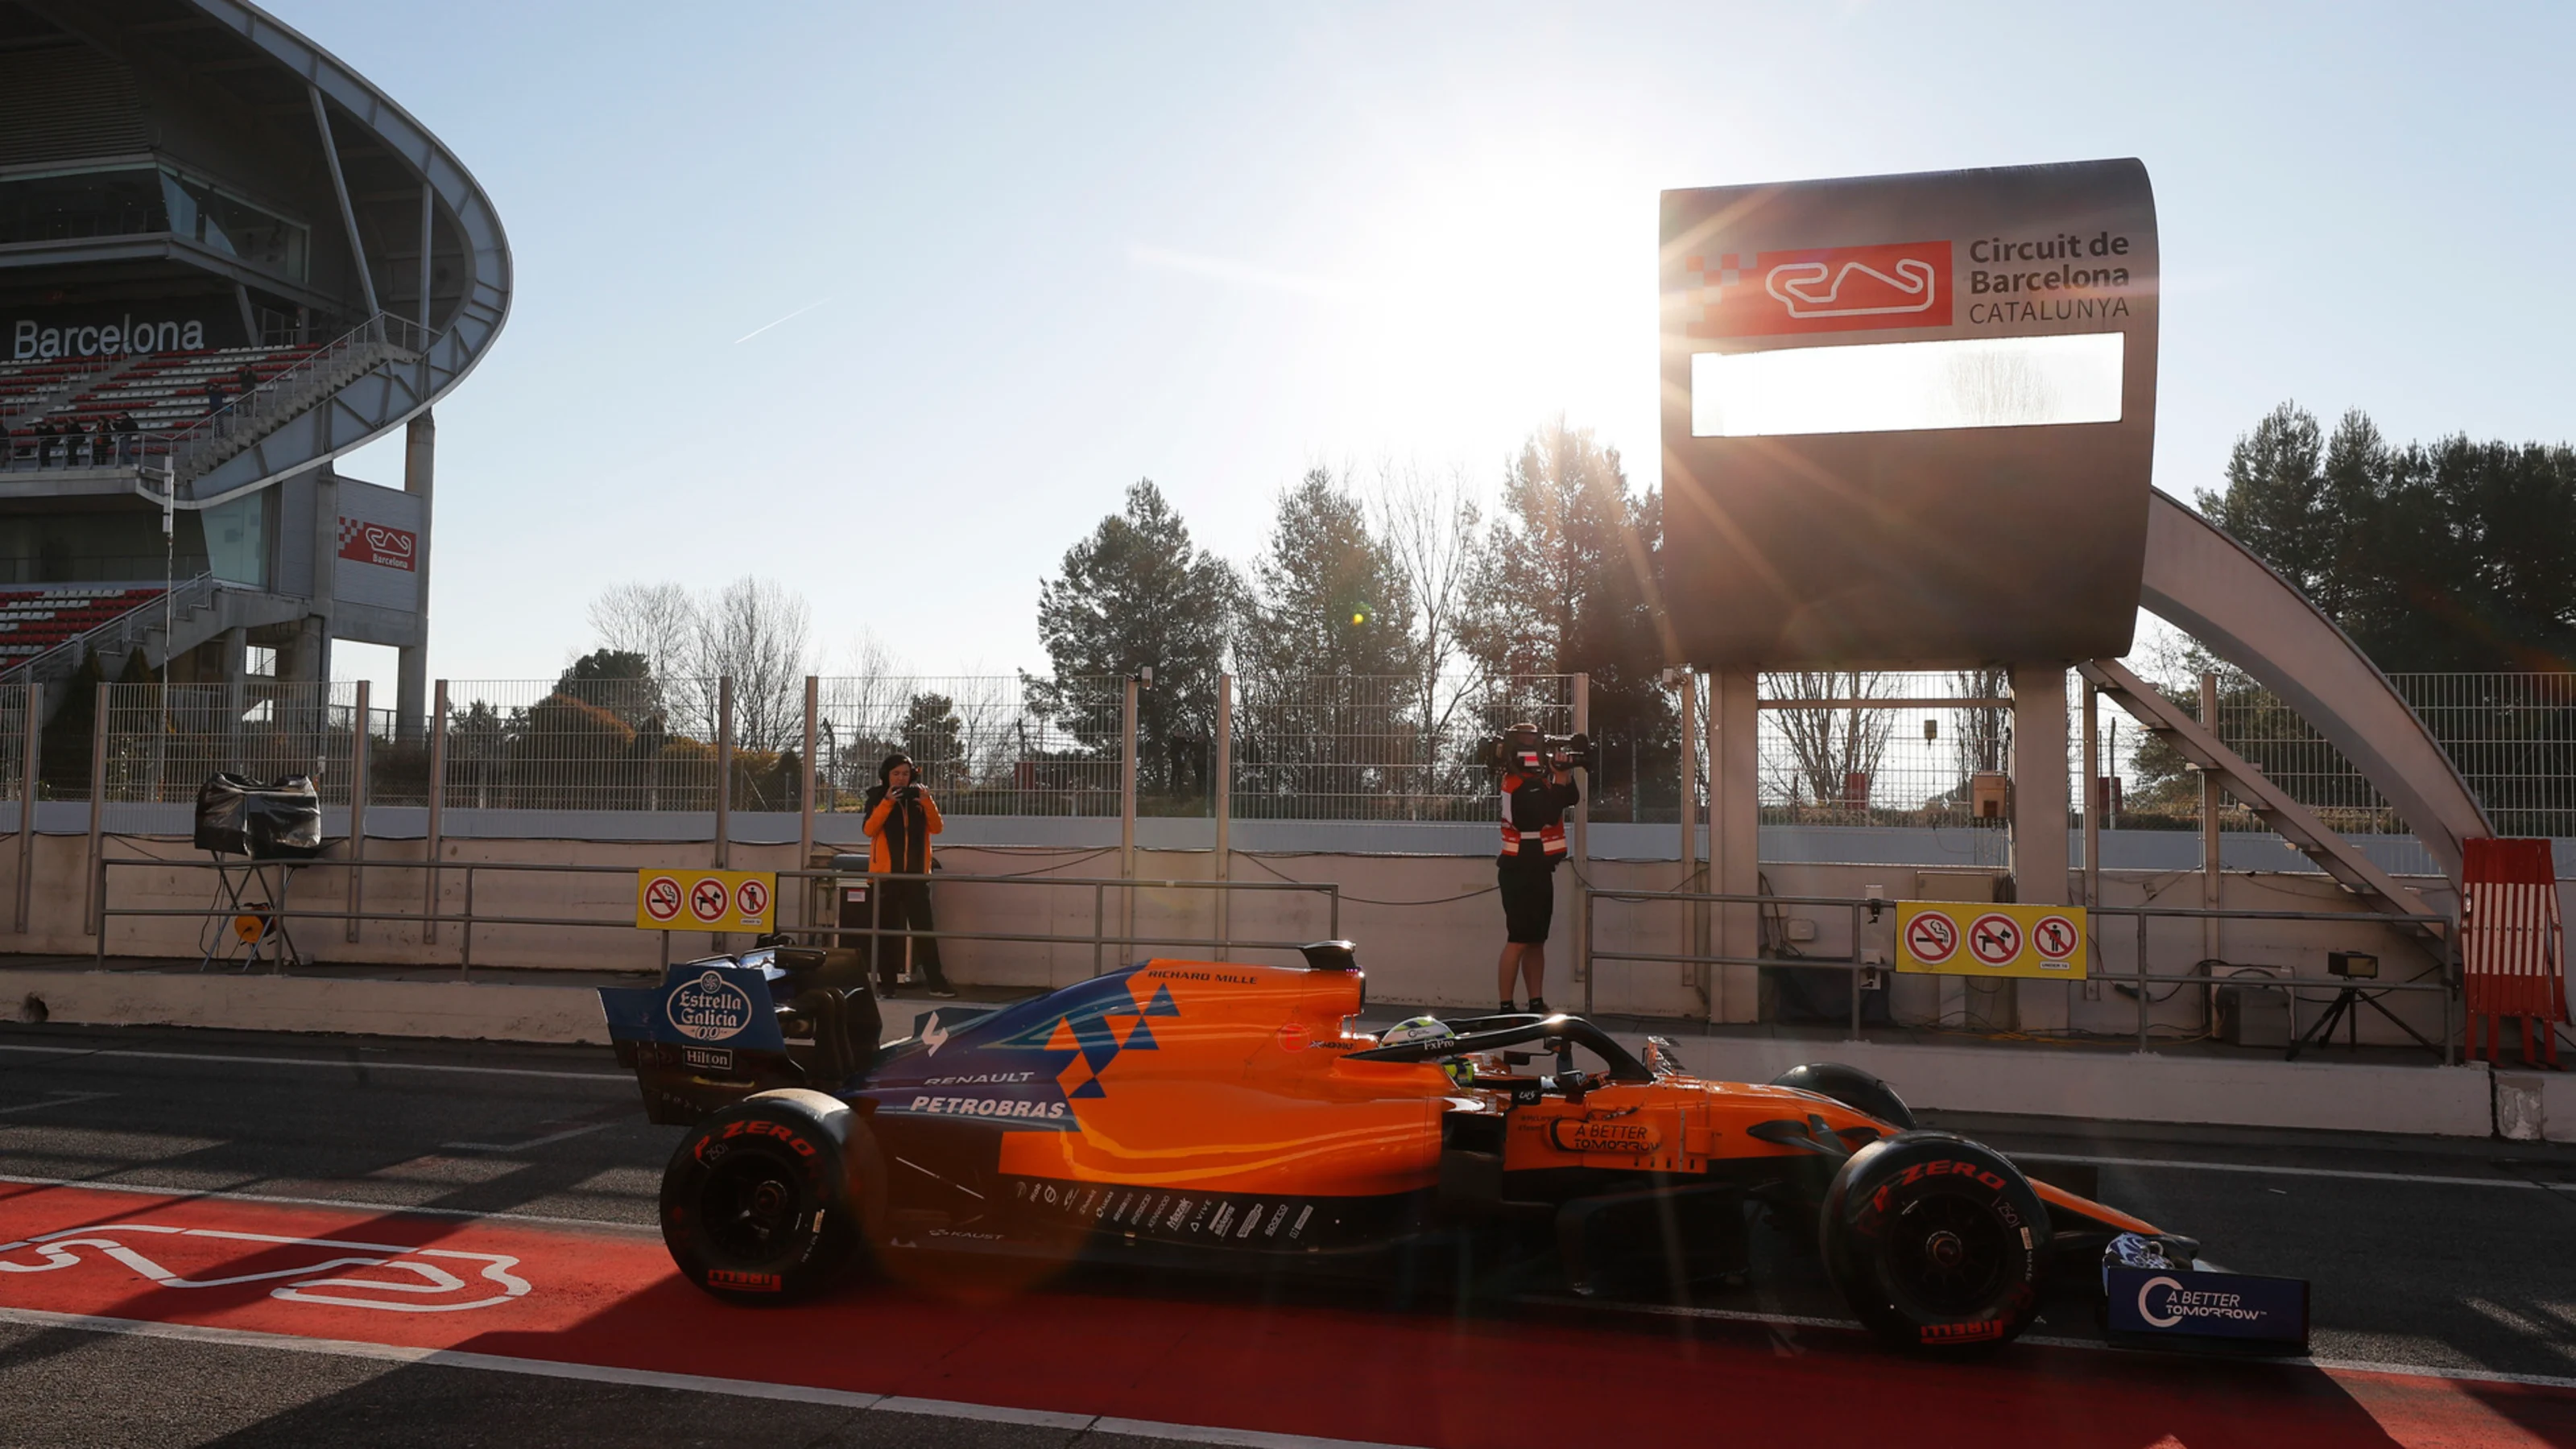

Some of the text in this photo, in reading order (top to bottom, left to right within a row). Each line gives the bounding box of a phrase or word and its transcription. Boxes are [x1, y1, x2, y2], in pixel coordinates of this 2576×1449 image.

[1970, 231, 2129, 263] Circuit de
[1971, 264, 2129, 294] Barcelona
[1970, 296, 2130, 324] CATALUNYA
[14, 313, 205, 359] Barcelona
[373, 553, 408, 568] Barcelona
[1147, 970, 1258, 985] RICHARD MILLE
[679, 991, 742, 1010] Estrella
[681, 1008, 738, 1027] Galicia
[1424, 1038, 1454, 1051] FxPro
[687, 1051, 728, 1065] Hilton
[924, 1071, 1035, 1085] RENAULT
[909, 1096, 1065, 1119] PETROBRAS
[694, 1121, 817, 1160] P ZERO
[1575, 1125, 1648, 1139] A BETTER
[1873, 1160, 2007, 1213] P ZERO
[1147, 1195, 1171, 1228] KENWOOD
[1166, 1197, 1191, 1229] Mazak
[1197, 1199, 1213, 1220] VIVE
[1264, 1203, 1289, 1237] sparco
[950, 1230, 1006, 1241] KAUST
[708, 1269, 782, 1292] PIRELLI
[2166, 1290, 2240, 1307] A BETTER
[1921, 1319, 2003, 1344] PIRELLI
